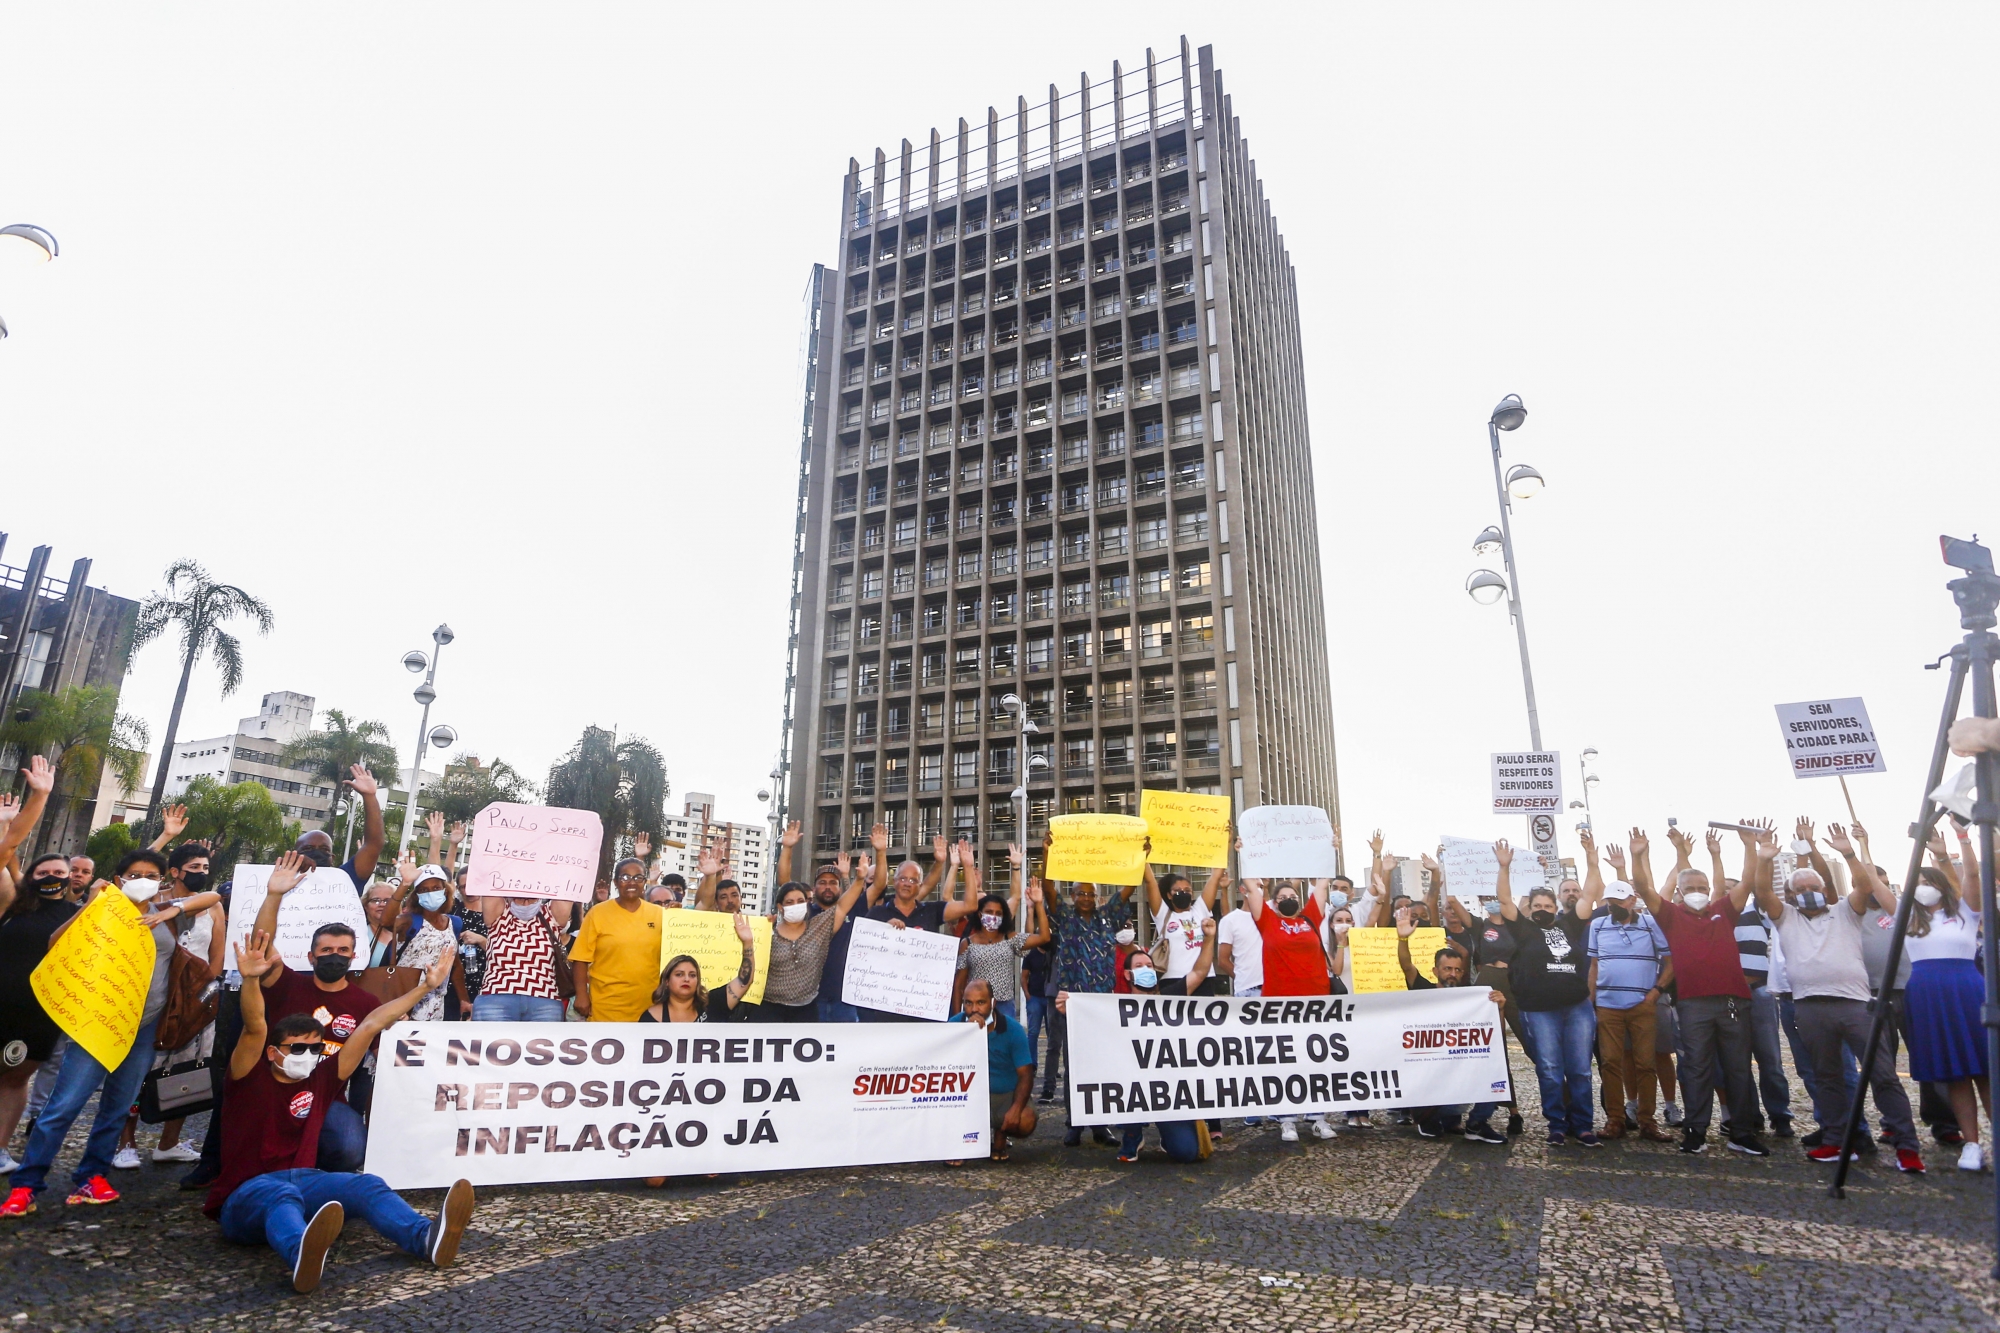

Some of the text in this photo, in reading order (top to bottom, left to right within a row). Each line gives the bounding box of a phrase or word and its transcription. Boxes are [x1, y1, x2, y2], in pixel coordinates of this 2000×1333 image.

[1809, 703, 1833, 715] SEM
[1789, 717, 1863, 733] SERVIDORES,
[1787, 738, 1795, 749] A
[1796, 735, 1838, 748] CIDADE
[1838, 732, 1870, 745] PARA
[1496, 754, 1554, 765] PAULO SERRA
[1794, 752, 1876, 770] SINDSERV
[1499, 767, 1553, 777] RESPEITE OS
[1500, 781, 1553, 790] SERVIDORES
[1494, 798, 1559, 808] SINDSERV
[309, 884, 323, 895] do
[1118, 998, 1356, 1028] PAULO SERRA:
[1402, 1027, 1494, 1049] SINDSERV
[393, 1030, 835, 1067] É NOSSO DIREITO:
[1131, 1032, 1350, 1069] VALORIZE OS
[1469, 1046, 1491, 1054] ANDRÉ
[852, 1072, 976, 1096] SINDSERV
[1076, 1069, 1402, 1115] TRABALHADORES!!!
[434, 1072, 801, 1114] REPOSIÇÃO DA
[939, 1093, 969, 1102] ANDRÉ
[455, 1110, 779, 1158] INFLAÇÃO JÁ
